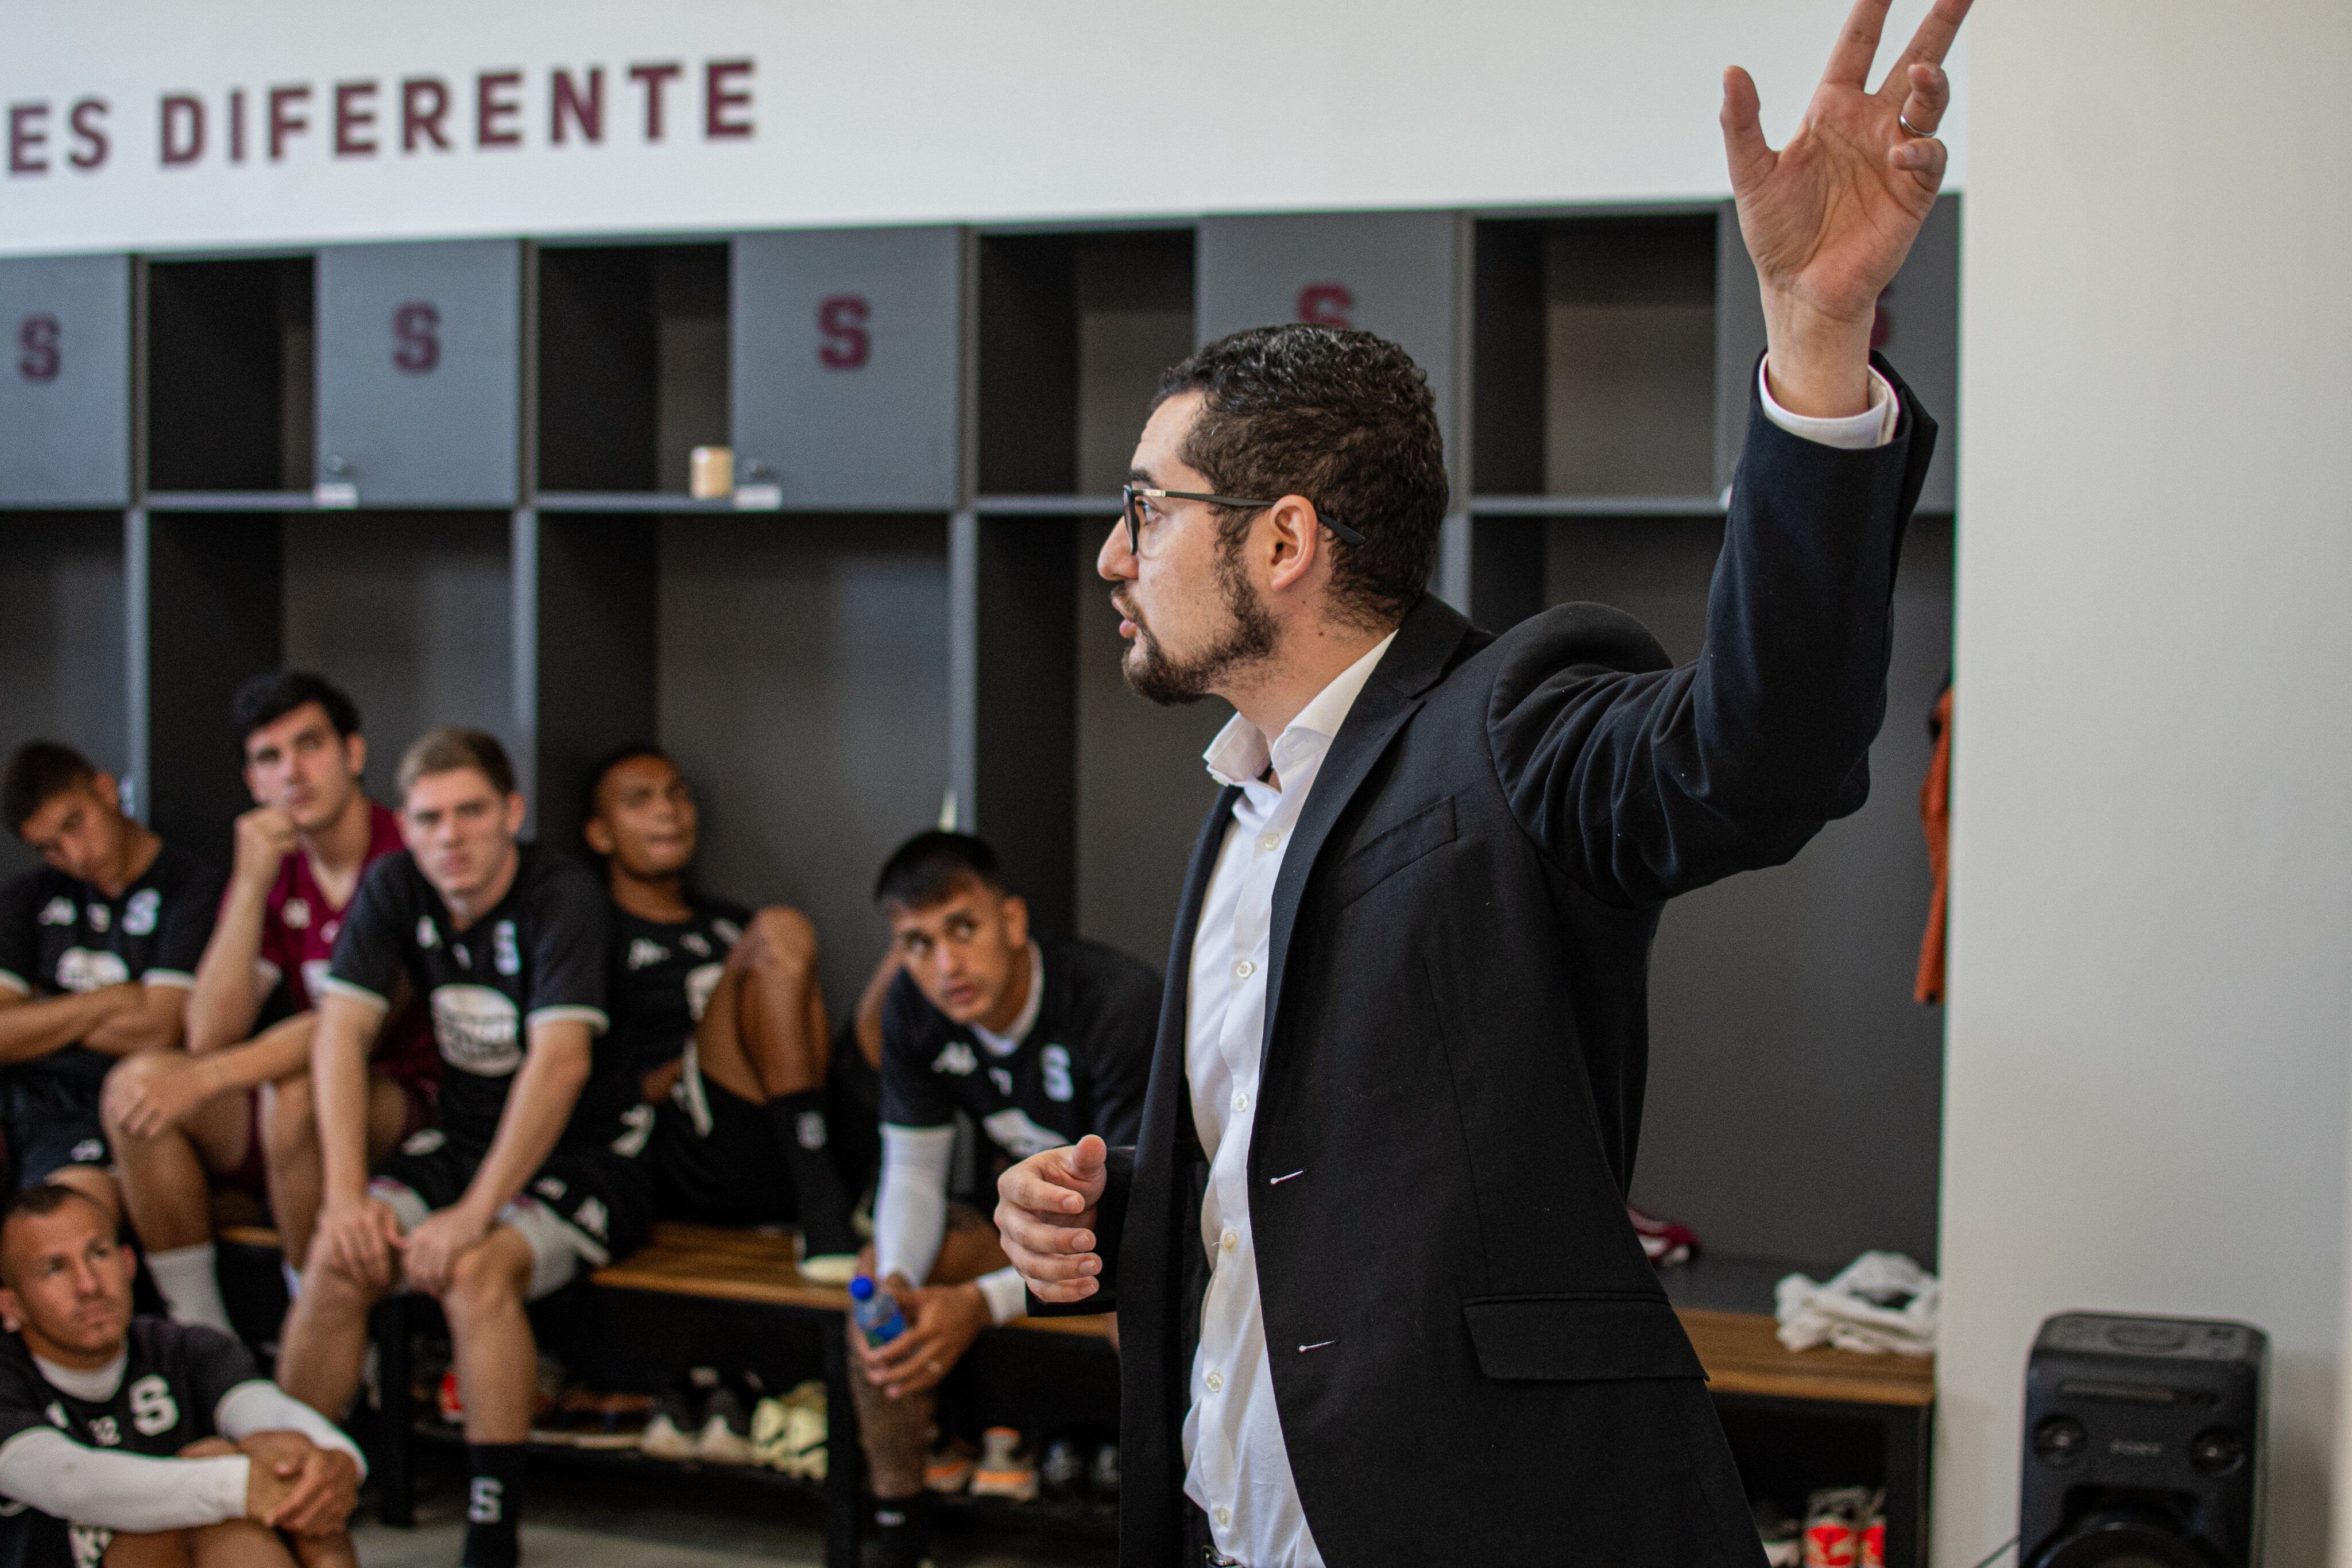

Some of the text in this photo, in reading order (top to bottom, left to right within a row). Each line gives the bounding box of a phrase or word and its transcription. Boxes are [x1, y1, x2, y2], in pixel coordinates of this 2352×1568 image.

[8, 58, 755, 176] ES DIFERENTE
[18, 312, 61, 381] S
[392, 301, 441, 373] S
[817, 293, 871, 369] S
[129, 1374, 178, 1437] S
[469, 1477, 503, 1524] S
